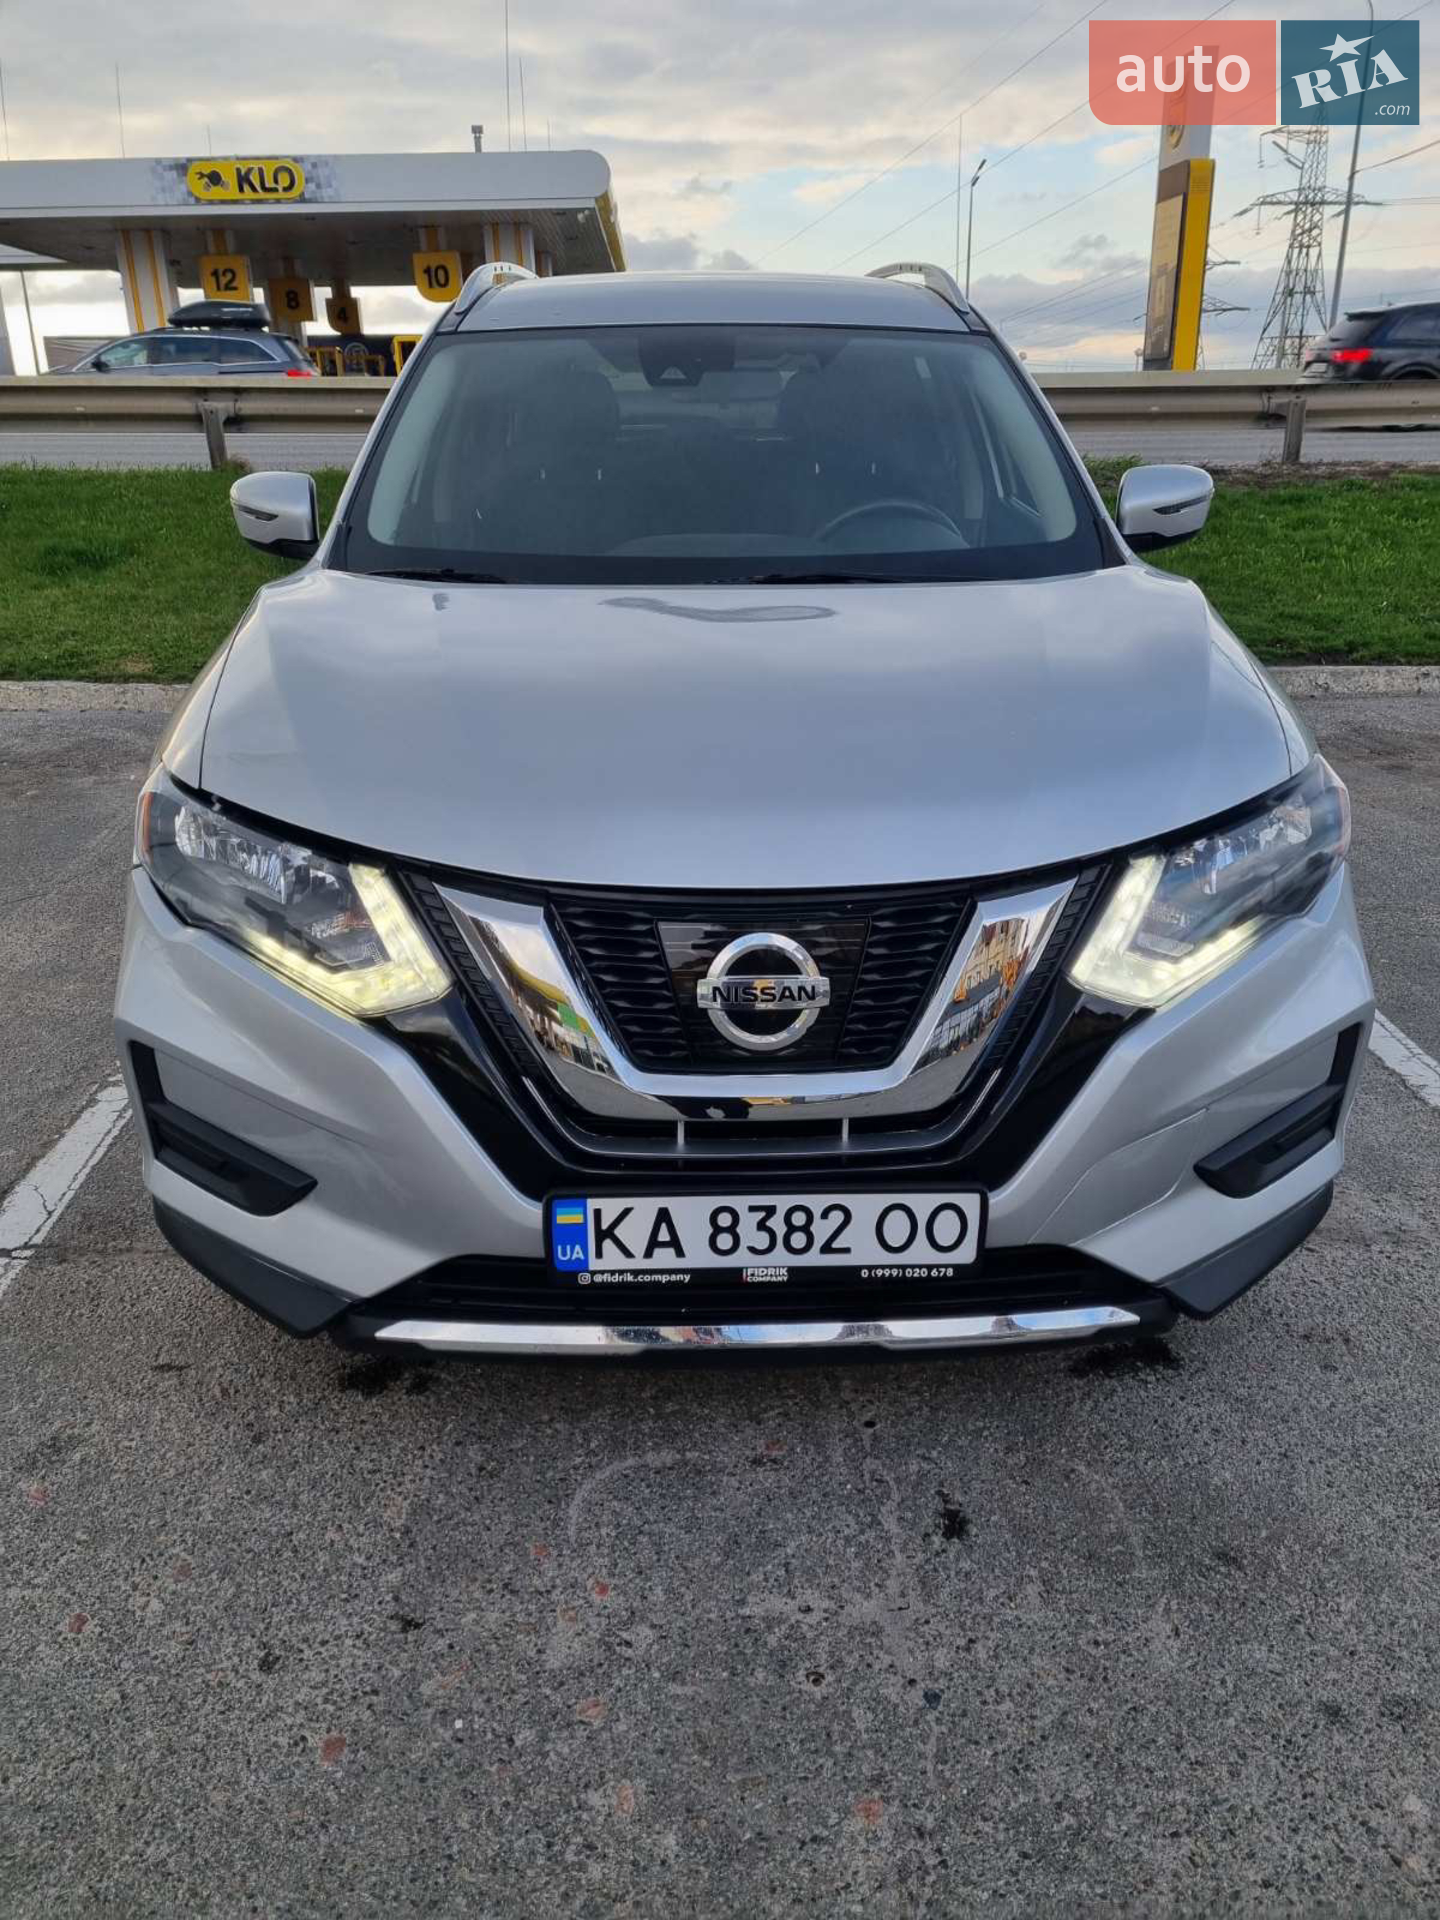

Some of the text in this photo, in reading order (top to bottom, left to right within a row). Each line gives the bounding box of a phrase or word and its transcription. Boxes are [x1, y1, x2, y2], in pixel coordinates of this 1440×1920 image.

[235, 165, 296, 194] KLO
[210, 268, 238, 291] 12
[423, 264, 450, 289] 10
[285, 290, 300, 310] 8
[336, 306, 349, 324] 4
[712, 985, 816, 1003] NISSAN
[593, 1202, 968, 1260] KA 8382 OO
[557, 1244, 585, 1261] UA
[593, 1272, 691, 1284] @fidrik.company
[746, 1275, 789, 1283] COMPANY
[747, 1267, 789, 1276] FIDRIK
[861, 1267, 954, 1279] 0 (999) 020 678
